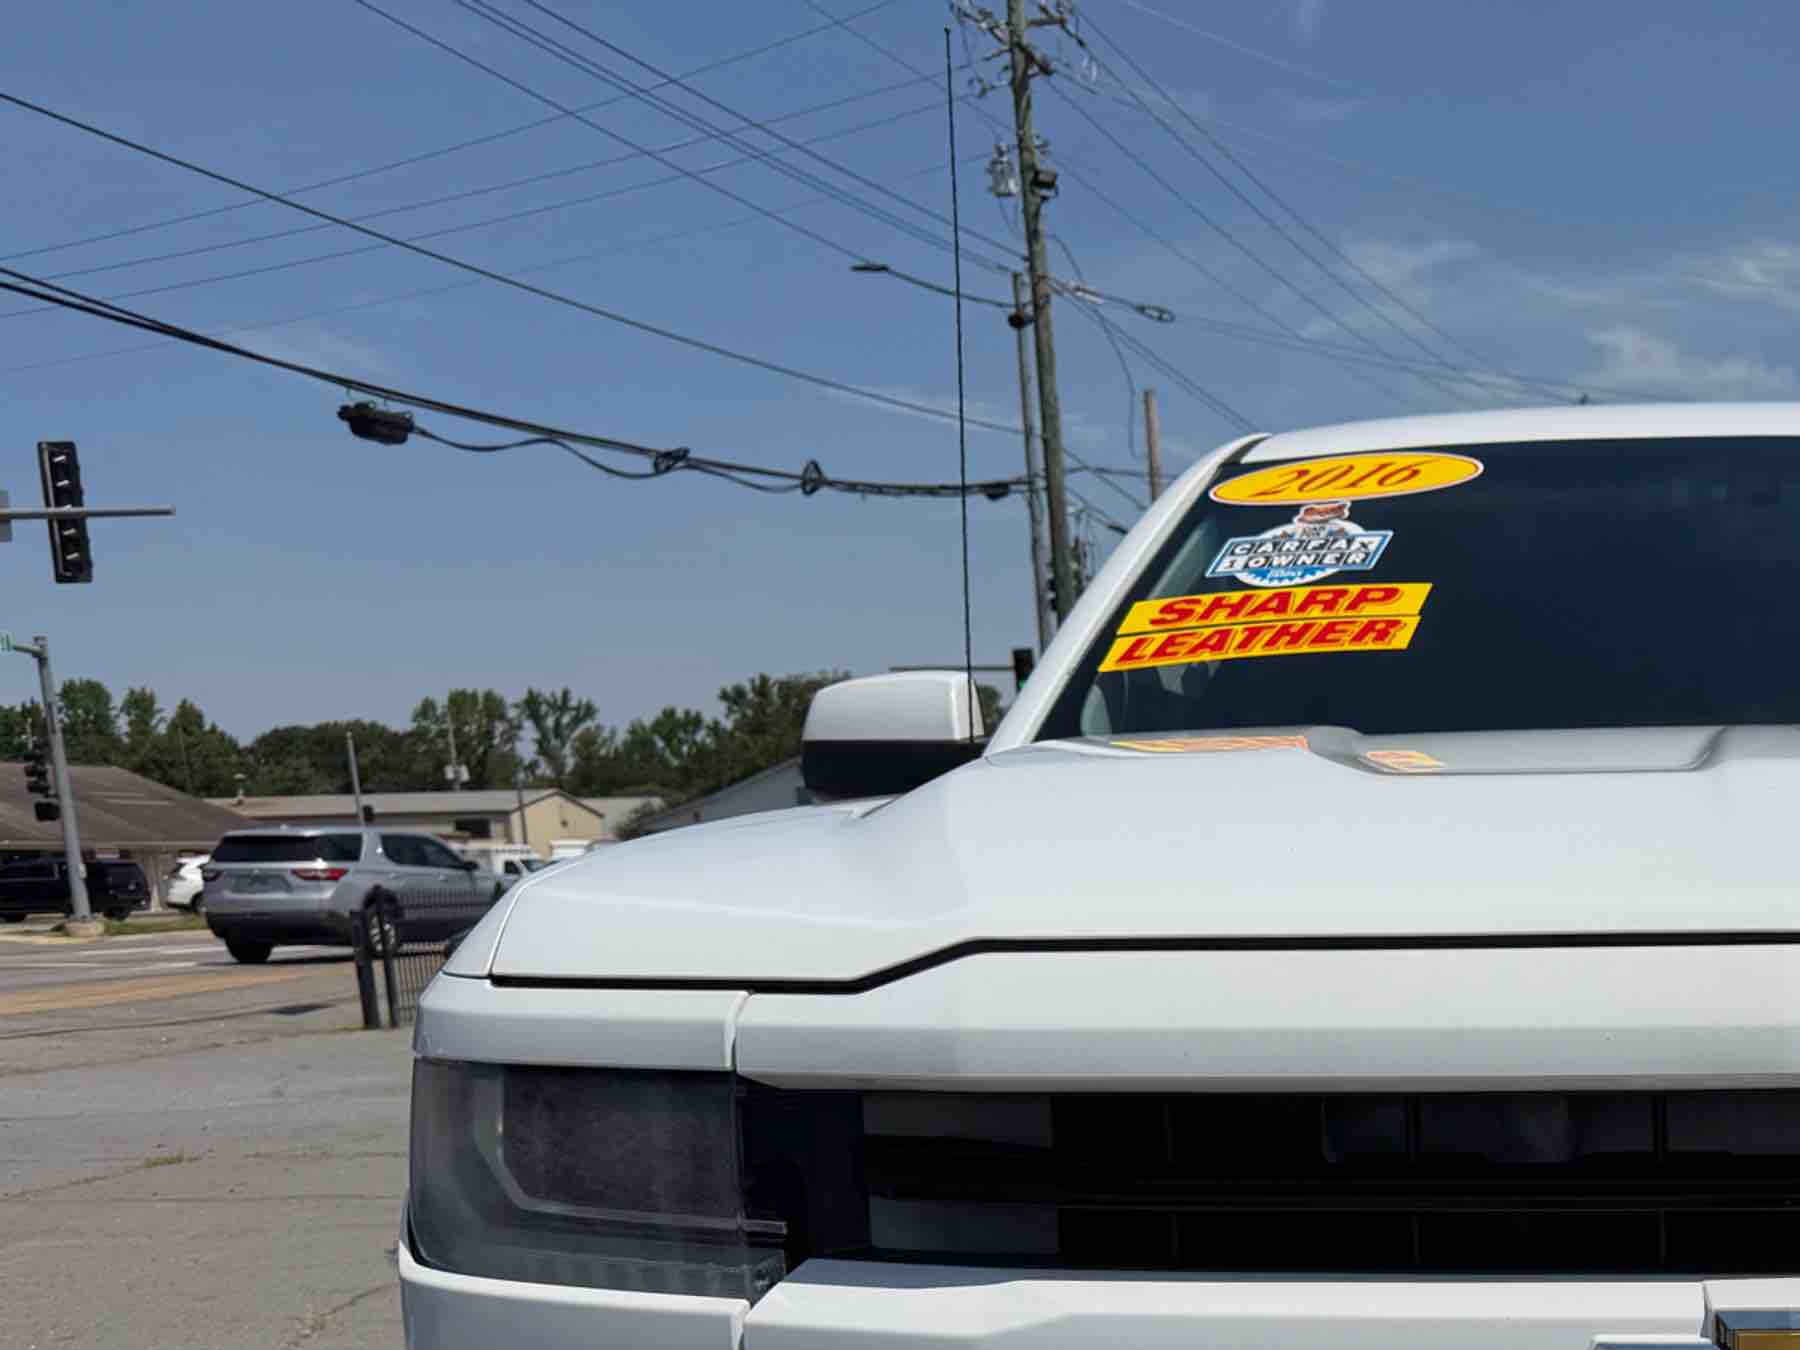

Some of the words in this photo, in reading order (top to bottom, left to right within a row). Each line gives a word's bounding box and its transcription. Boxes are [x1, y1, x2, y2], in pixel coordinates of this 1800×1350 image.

[1249, 459, 1439, 497] 2016
[1233, 536, 1378, 555] CARFAX
[1247, 552, 1367, 569] OWNER
[1149, 586, 1404, 626] SHARP
[1116, 619, 1407, 664] LEATHER
